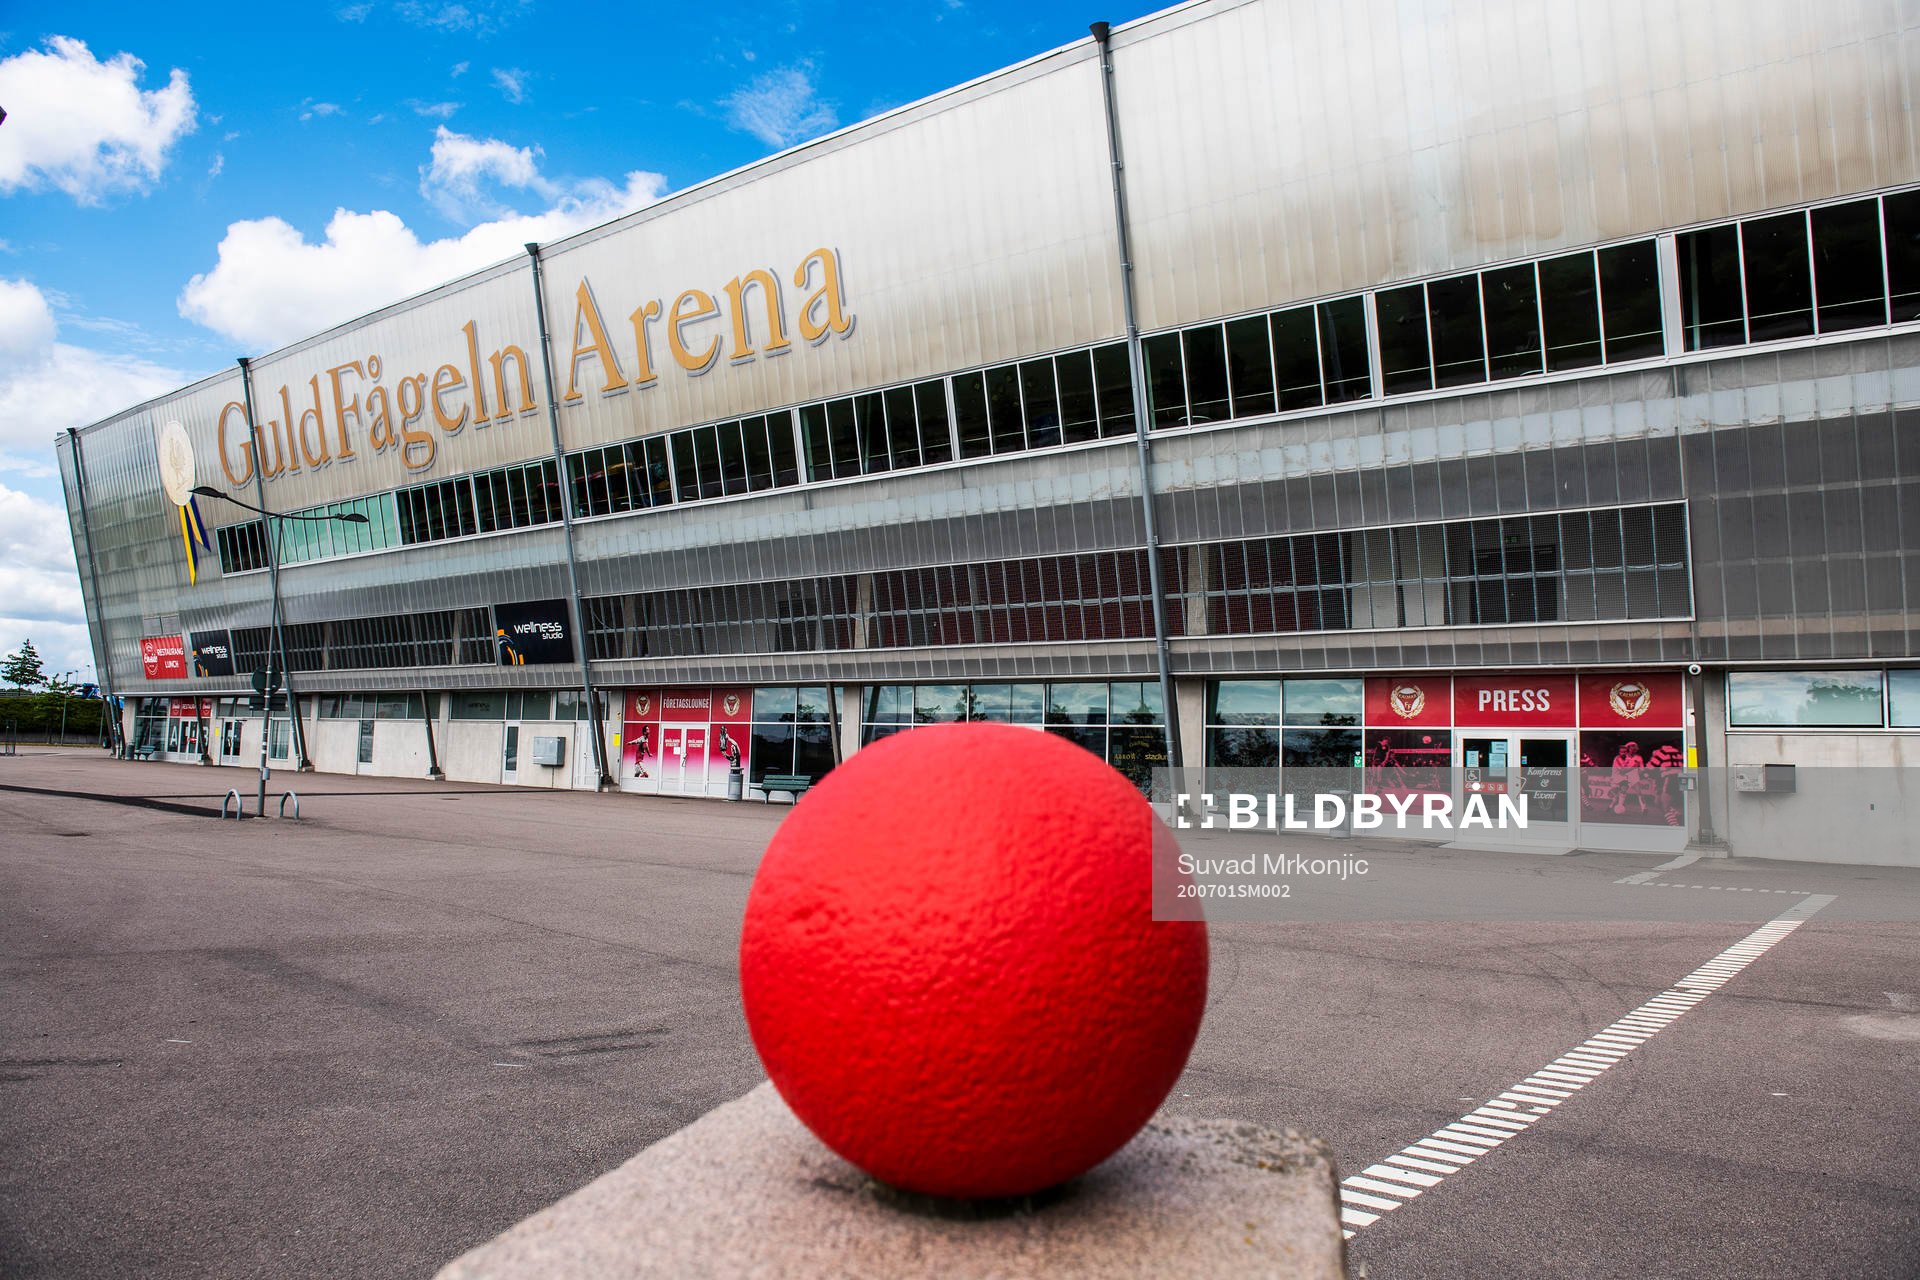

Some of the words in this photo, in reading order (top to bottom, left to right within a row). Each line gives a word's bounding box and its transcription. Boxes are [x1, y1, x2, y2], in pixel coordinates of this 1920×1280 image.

[217, 319, 538, 487] GuldFågeln
[564, 247, 854, 404] Arena
[514, 621, 562, 634] wellness
[542, 631, 563, 640] studio
[663, 697, 709, 709] FÖRETAGSLOUNGE
[1478, 688, 1550, 712] PRESS
[1527, 767, 1563, 778] Konferens
[1533, 791, 1557, 800] Event
